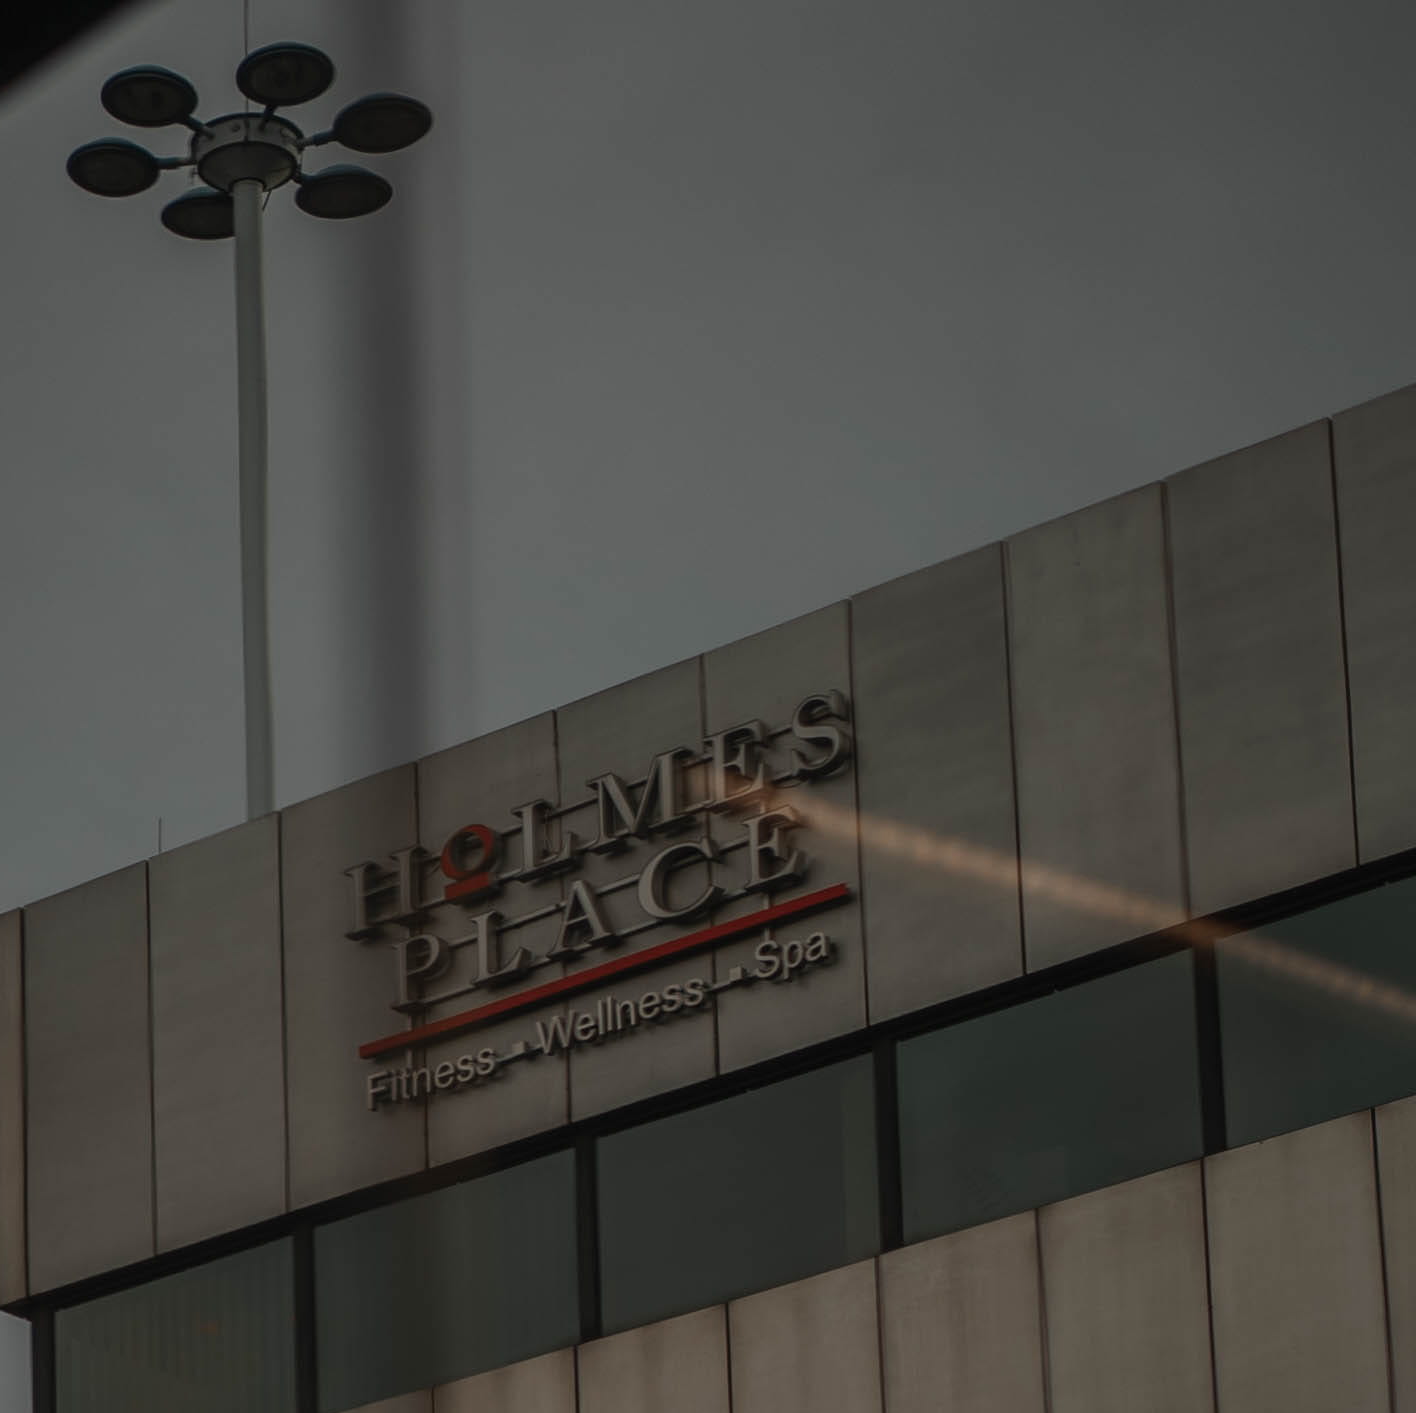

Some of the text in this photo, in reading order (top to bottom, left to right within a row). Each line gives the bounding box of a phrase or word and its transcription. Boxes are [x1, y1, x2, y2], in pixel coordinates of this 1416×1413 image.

[344, 689, 850, 940] HOLMES
[391, 804, 806, 1014] PLACE
[366, 928, 834, 1112] Fitness Wellness Spa
